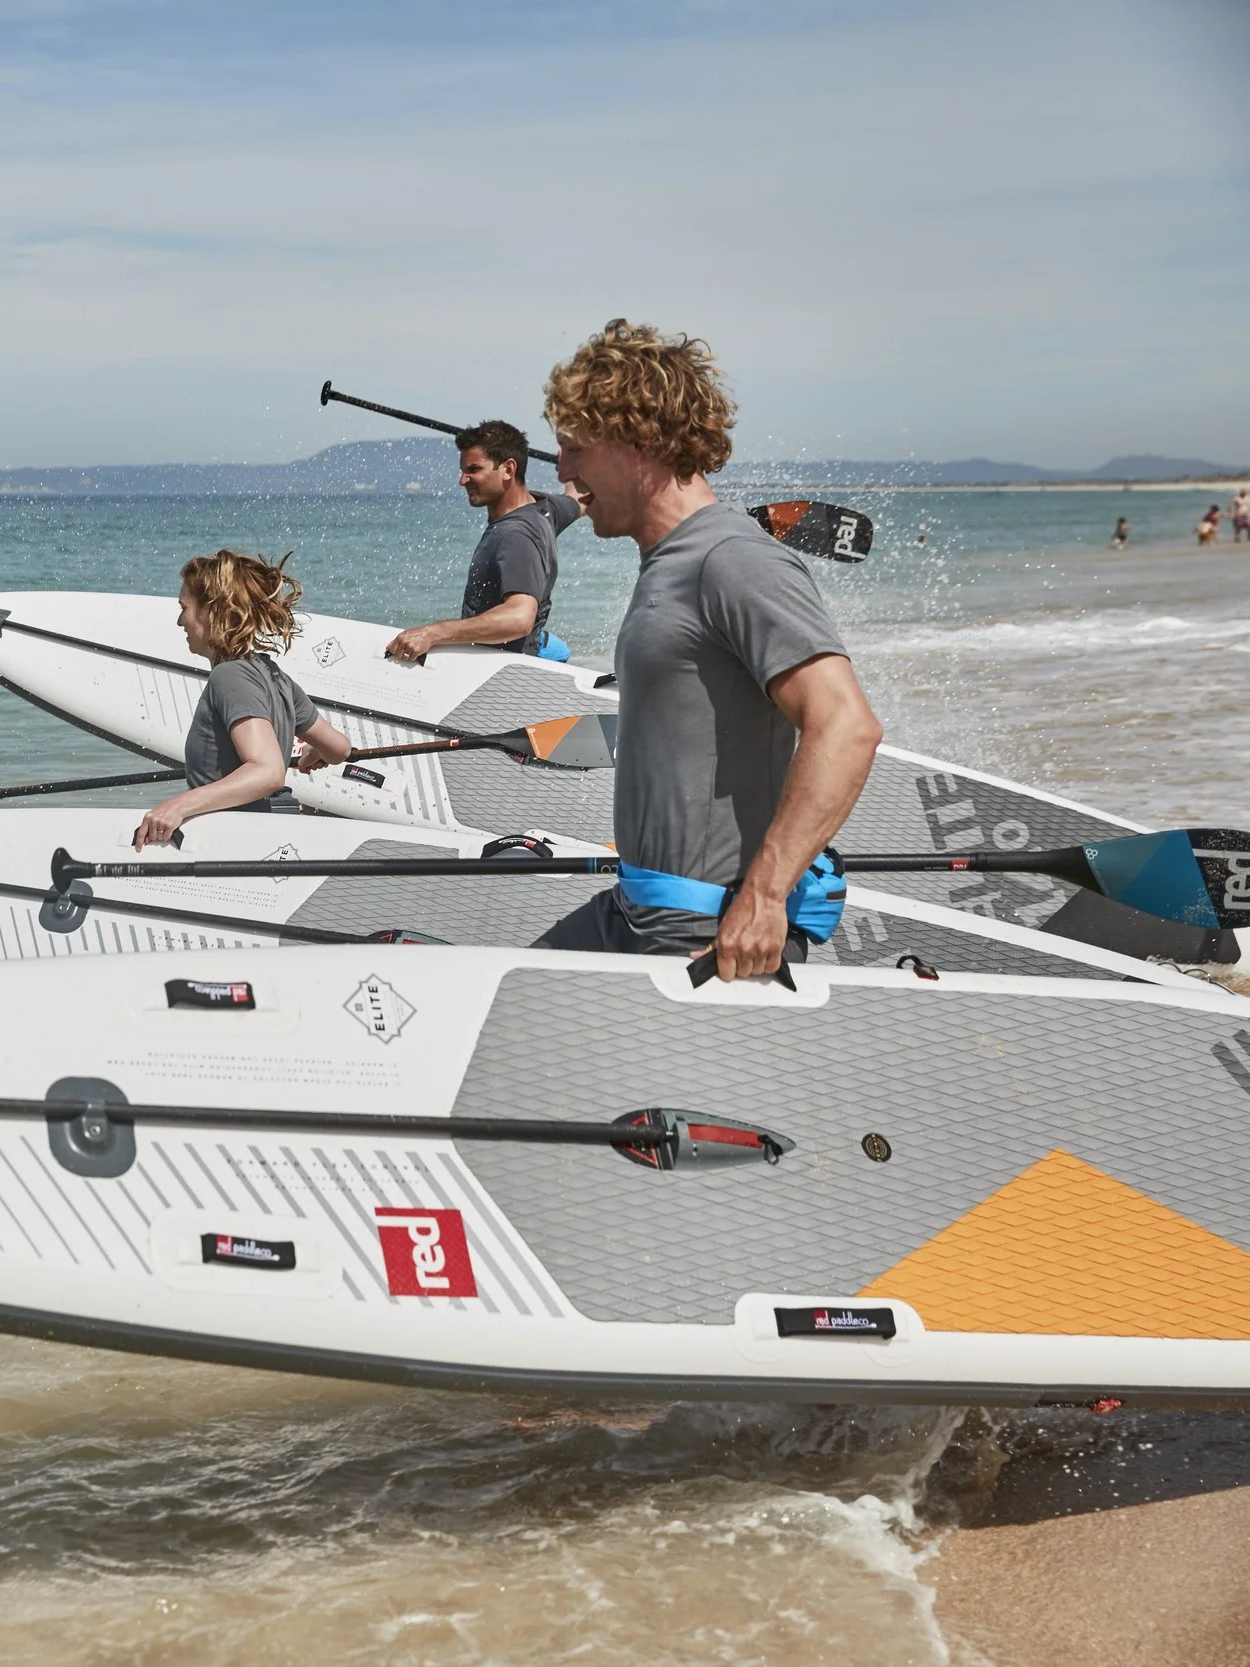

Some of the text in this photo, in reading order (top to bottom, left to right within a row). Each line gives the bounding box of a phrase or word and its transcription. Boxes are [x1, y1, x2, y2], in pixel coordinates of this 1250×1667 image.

[834, 515, 867, 560] red
[321, 641, 334, 663] ELITE
[1192, 848, 1250, 910] red
[367, 985, 385, 1032] ELITE
[375, 1214, 450, 1290] red
[816, 1310, 829, 1325] red
